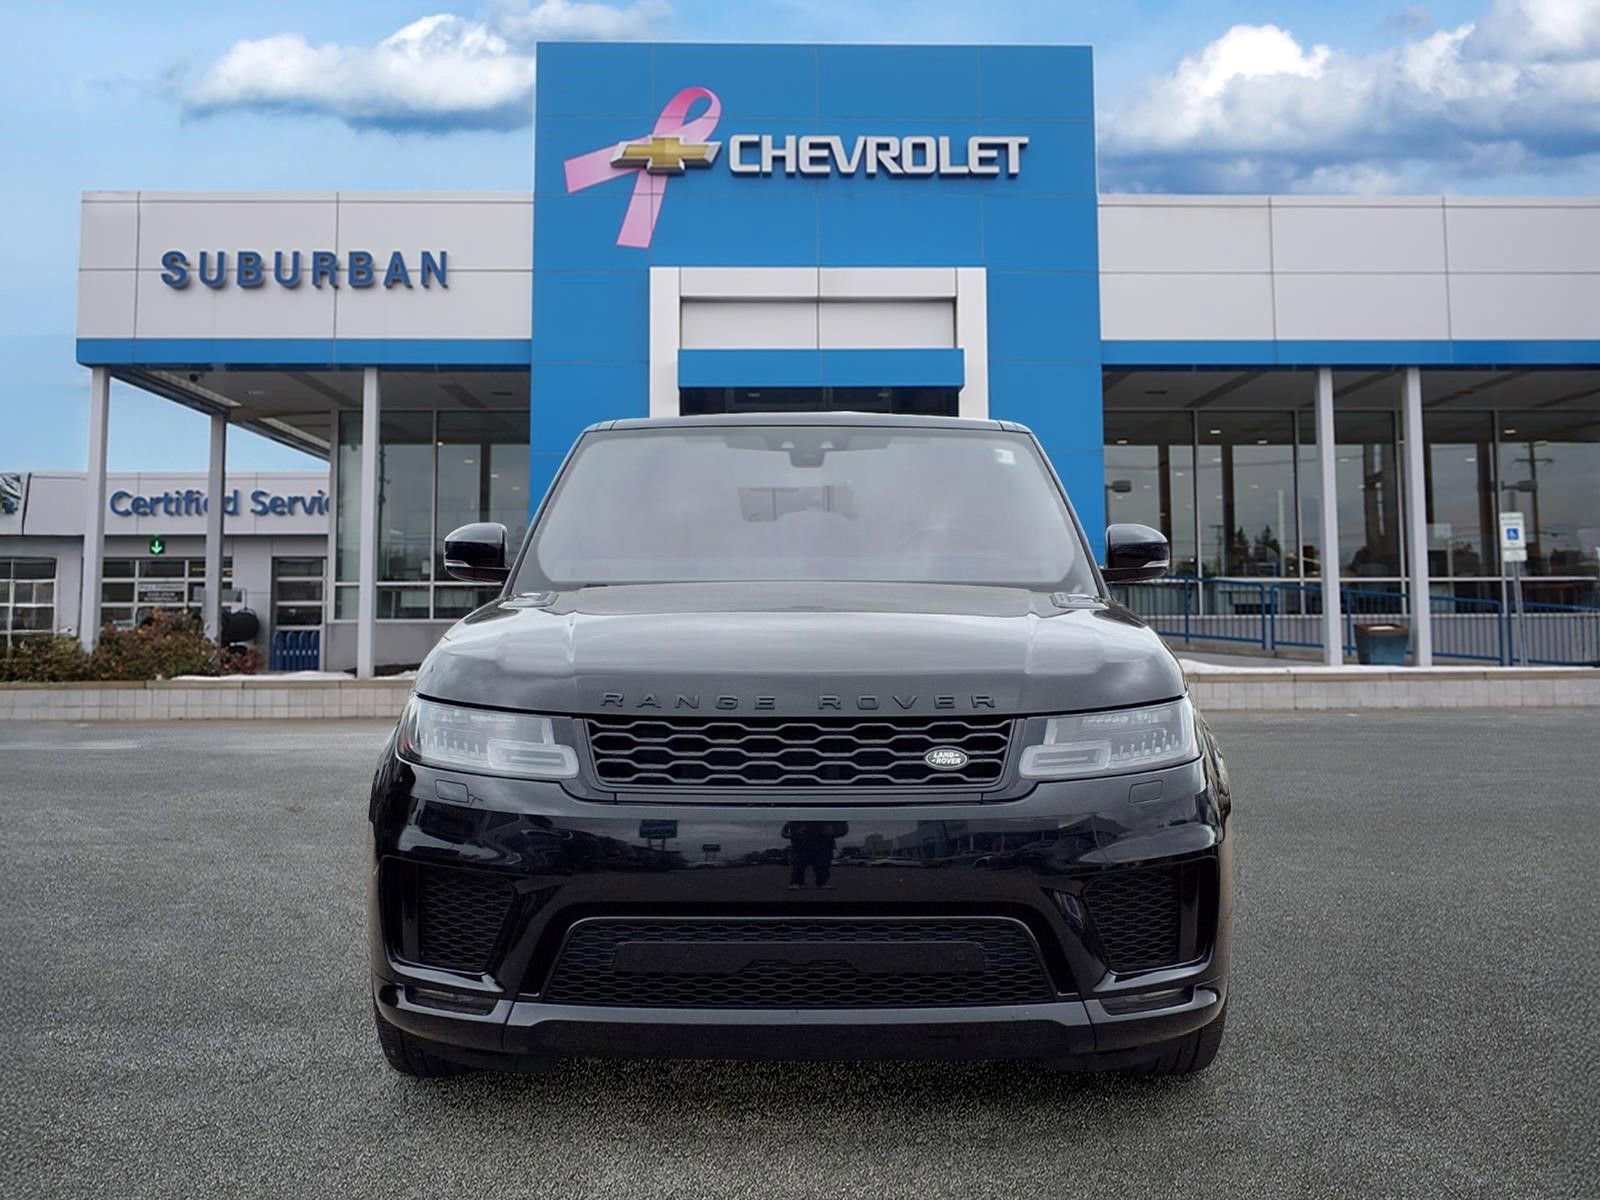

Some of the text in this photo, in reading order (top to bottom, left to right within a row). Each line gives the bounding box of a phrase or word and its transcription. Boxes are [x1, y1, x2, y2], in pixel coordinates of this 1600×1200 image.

[729, 134, 1030, 176] CHEVROLET
[161, 250, 448, 289] SUBURBAN
[110, 489, 241, 517] Certifid
[600, 692, 997, 711] RANGE ROVER
